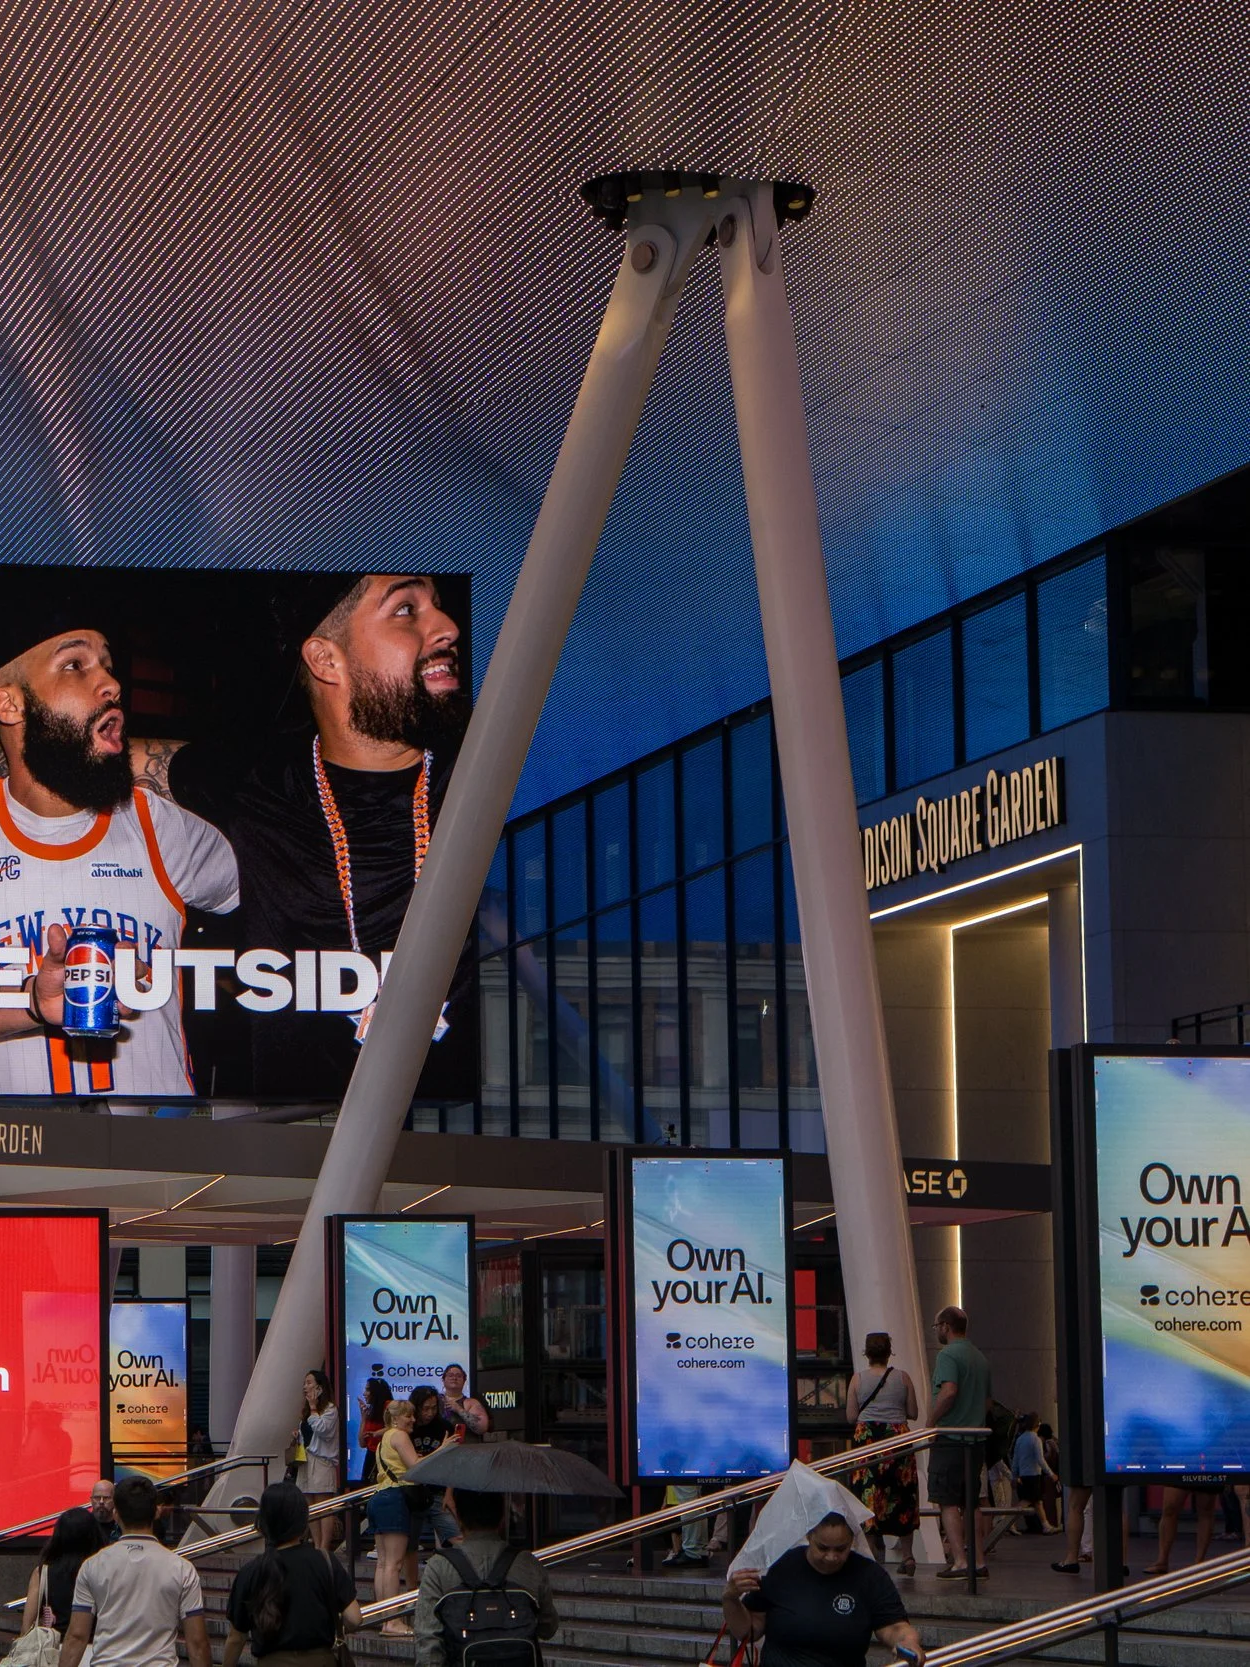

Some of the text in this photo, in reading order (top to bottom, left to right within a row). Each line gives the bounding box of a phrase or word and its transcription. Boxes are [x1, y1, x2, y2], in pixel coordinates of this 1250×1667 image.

[859, 756, 1059, 890] DISON SQUARE GARDEN
[91, 868, 143, 878] abu dhabi
[65, 968, 111, 983] PEPSI
[1140, 1162, 1241, 1205] Own
[1120, 1216, 1219, 1259] your
[667, 1238, 746, 1272] Own
[372, 1287, 437, 1315] Own
[651, 1272, 773, 1313] your AI.
[1165, 1285, 1250, 1306] cohere
[360, 1314, 459, 1347] your AI.
[1154, 1316, 1242, 1332] cohere.com
[685, 1333, 755, 1349] cohere
[117, 1350, 163, 1369] Own
[677, 1357, 745, 1369] cohere.com
[109, 1368, 179, 1393] your AI.
[387, 1364, 444, 1378] cohere
[127, 1404, 169, 1414] cohere
[485, 1391, 516, 1409] STATION
